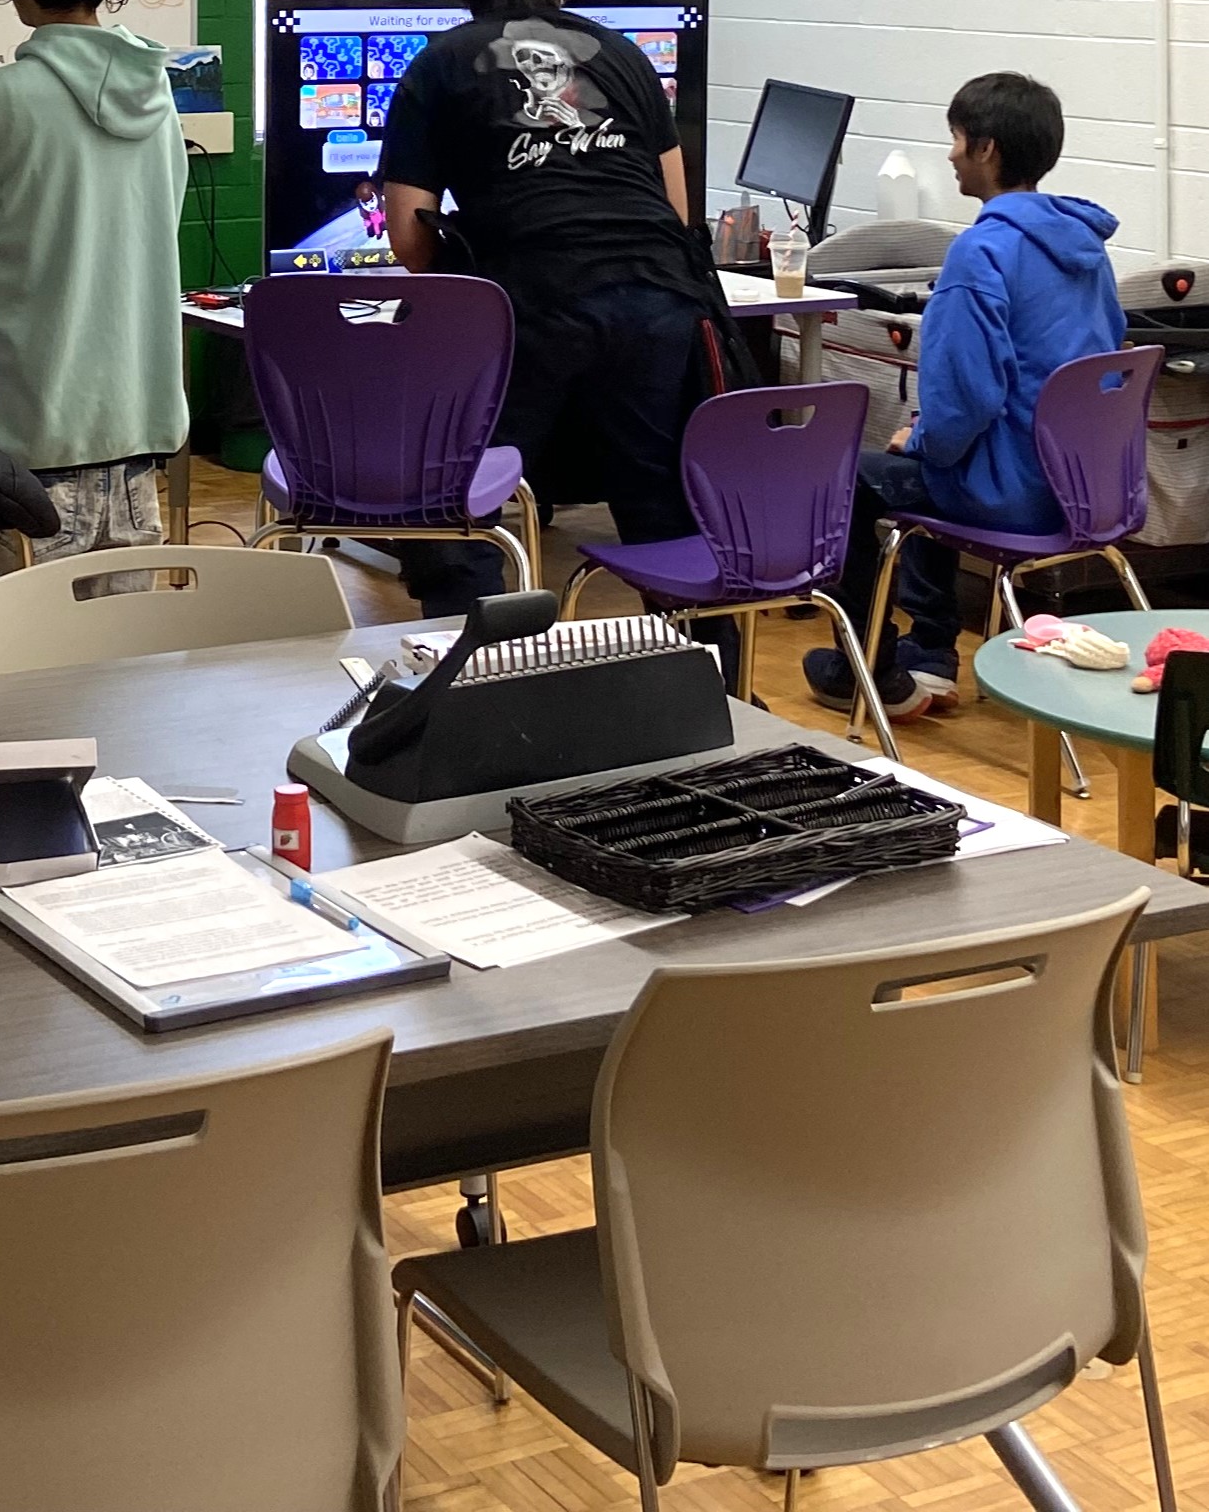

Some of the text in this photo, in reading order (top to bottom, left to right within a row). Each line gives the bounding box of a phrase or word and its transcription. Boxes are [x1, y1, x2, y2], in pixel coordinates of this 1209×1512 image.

[368, 15, 413, 27] Waiting
[416, 15, 429, 26] for
[507, 117, 626, 171] Say When
